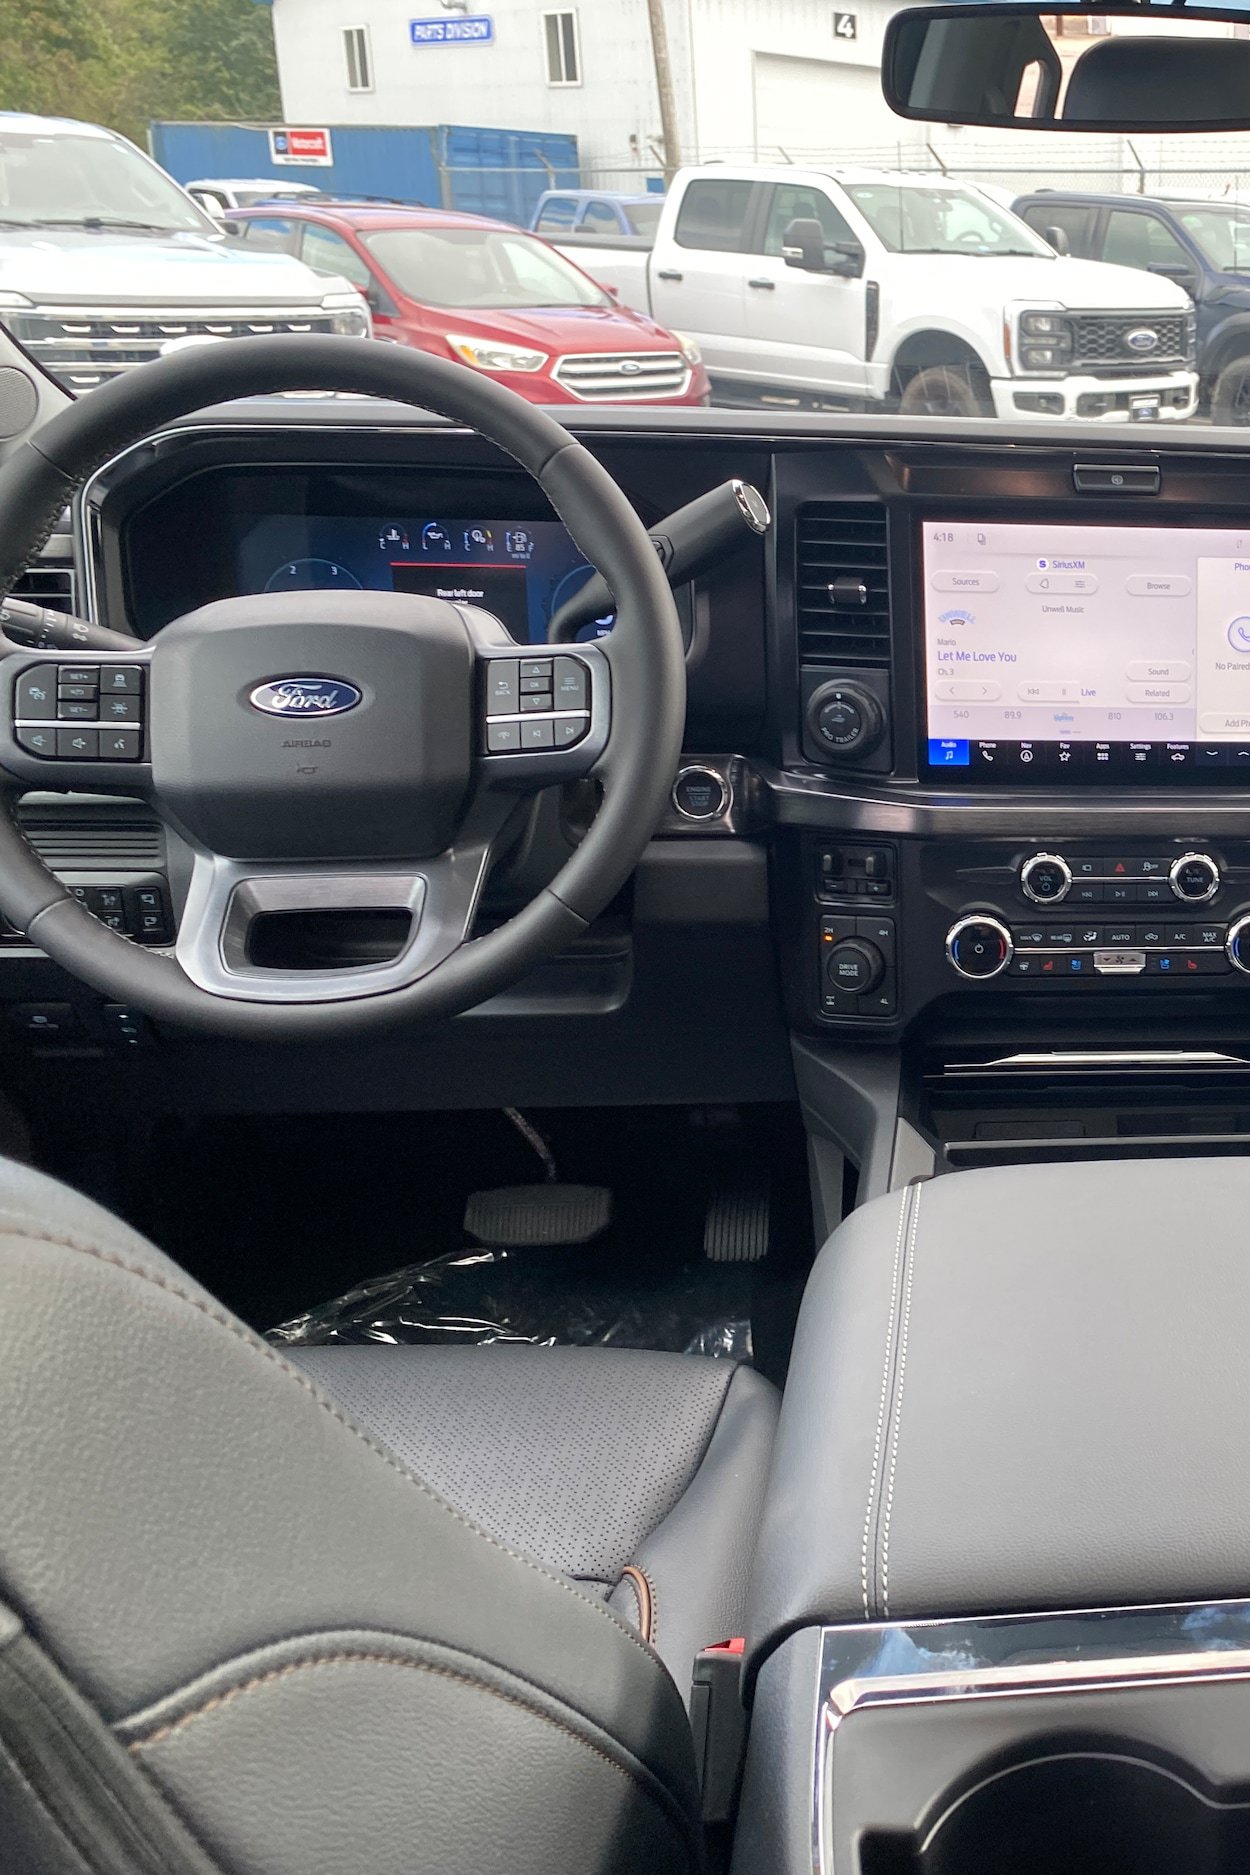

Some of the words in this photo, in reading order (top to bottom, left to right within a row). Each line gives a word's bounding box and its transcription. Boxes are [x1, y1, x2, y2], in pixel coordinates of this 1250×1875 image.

[415, 24, 444, 40] PARTS
[446, 22, 487, 39] DIVISION
[837, 15, 854, 38] 4
[933, 532, 954, 543] 4:18
[402, 542, 410, 550] H
[422, 542, 429, 550] L
[487, 544, 494, 552] H
[515, 544, 526, 552] 85
[1052, 560, 1085, 570] SiriusXM
[289, 566, 296, 575] 2
[331, 566, 338, 575] 3
[952, 577, 980, 587] Sources
[1146, 582, 1171, 591] Browse
[436, 588, 453, 597] Rear
[454, 588, 467, 598] left
[467, 589, 484, 598] door
[1042, 605, 1065, 614] Unwell
[1066, 605, 1085, 614] Music
[937, 638, 957, 647] Mario
[937, 651, 954, 662] Let
[955, 651, 972, 662] Me
[973, 651, 997, 663] Love
[998, 651, 1018, 663] You
[1148, 667, 1170, 676] Sound
[1215, 662, 1226, 671] No
[1227, 662, 1250, 672] Paired
[271, 684, 338, 710] Ford
[1081, 688, 1097, 697] Live
[1145, 689, 1171, 698] Related
[953, 710, 970, 719] 540
[1004, 710, 1022, 720] 89.9
[1108, 712, 1122, 721] 810
[1154, 712, 1174, 721] 106.3
[1225, 719, 1240, 728] Add
[821, 727, 834, 741] PRO
[835, 727, 860, 743] TRAILER
[281, 739, 332, 749] AIRBAG
[940, 741, 958, 749] Audio
[979, 741, 997, 750] Phone
[1020, 742, 1033, 750] Nav
[1059, 742, 1071, 750] Fav
[1095, 743, 1111, 751] Apps
[1129, 743, 1152, 751] Settings
[1166, 743, 1190, 751] Features
[1174, 933, 1186, 941] A/C
[839, 969, 859, 977] MODE
[880, 997, 889, 1005] 4L
